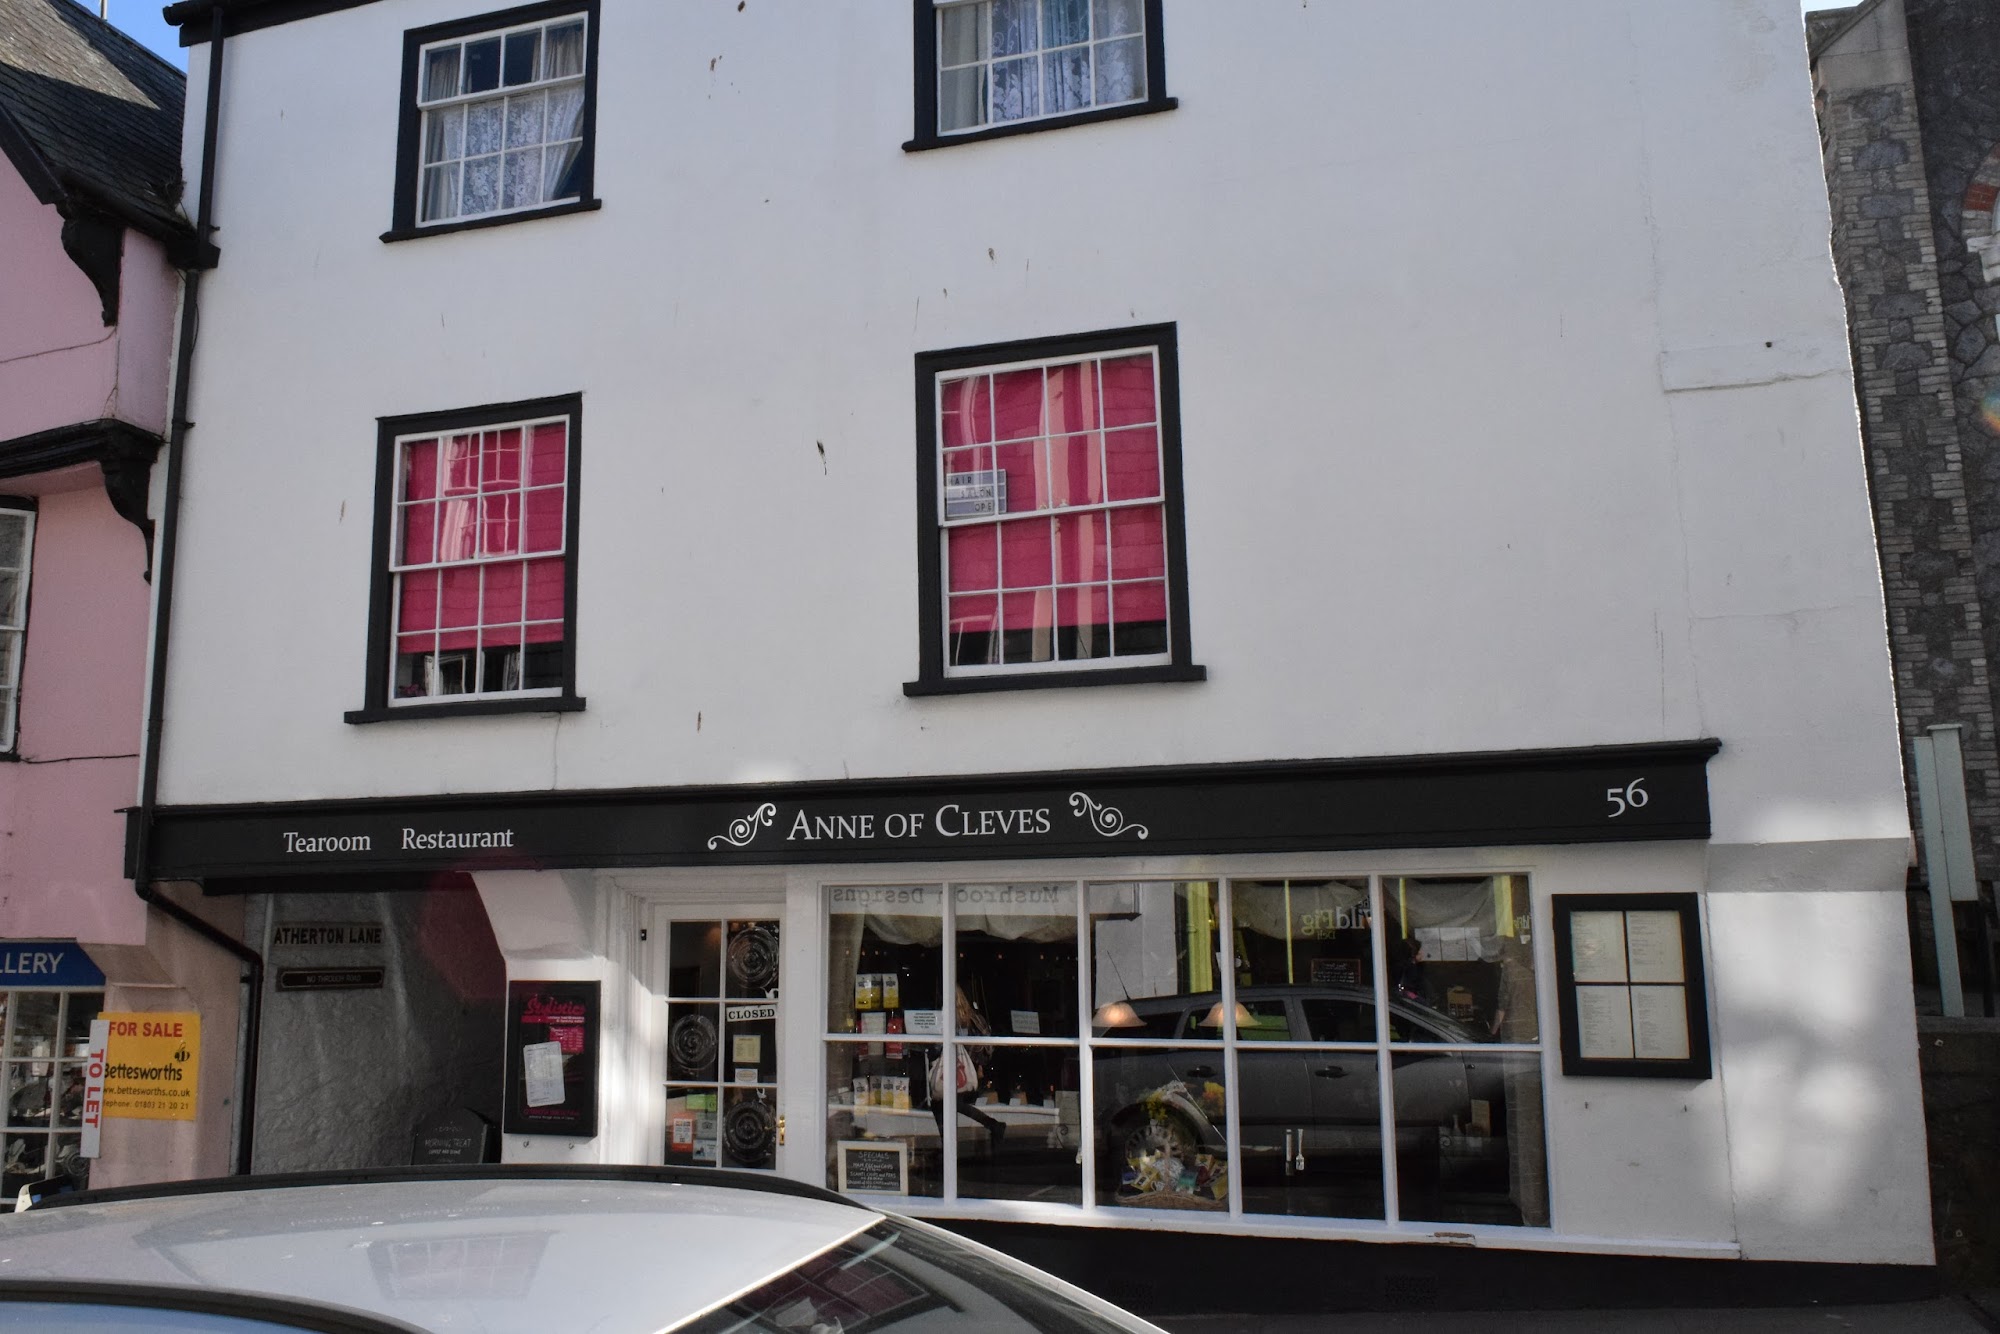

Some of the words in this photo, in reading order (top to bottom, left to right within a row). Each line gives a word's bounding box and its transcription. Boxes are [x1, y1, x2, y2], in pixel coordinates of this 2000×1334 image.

[961, 488, 992, 499] SALON
[1607, 777, 1649, 818] 56
[786, 809, 875, 840] ANNE
[884, 813, 924, 838] OF
[935, 804, 1051, 836] CLEVES
[283, 832, 371, 853] Tearoom
[401, 827, 514, 850] Restaurant
[274, 928, 343, 945] ATHERTON
[349, 927, 382, 944] LANE
[0, 952, 64, 974] LERY
[318, 975, 344, 983] THROUGH
[346, 974, 362, 982] ROAD
[728, 1008, 775, 1020] CLOSED
[108, 1022, 137, 1036] FOR
[142, 1022, 183, 1037] SALE
[88, 1048, 105, 1078] TO
[104, 1063, 182, 1081] Bettesworths
[103, 1086, 190, 1097] ww.bettesworths.co.uk
[85, 1086, 101, 1128] LET
[135, 1100, 155, 1109] 01803
[180, 1102, 189, 1110] 21
[858, 1151, 890, 1159] SPECIALS
